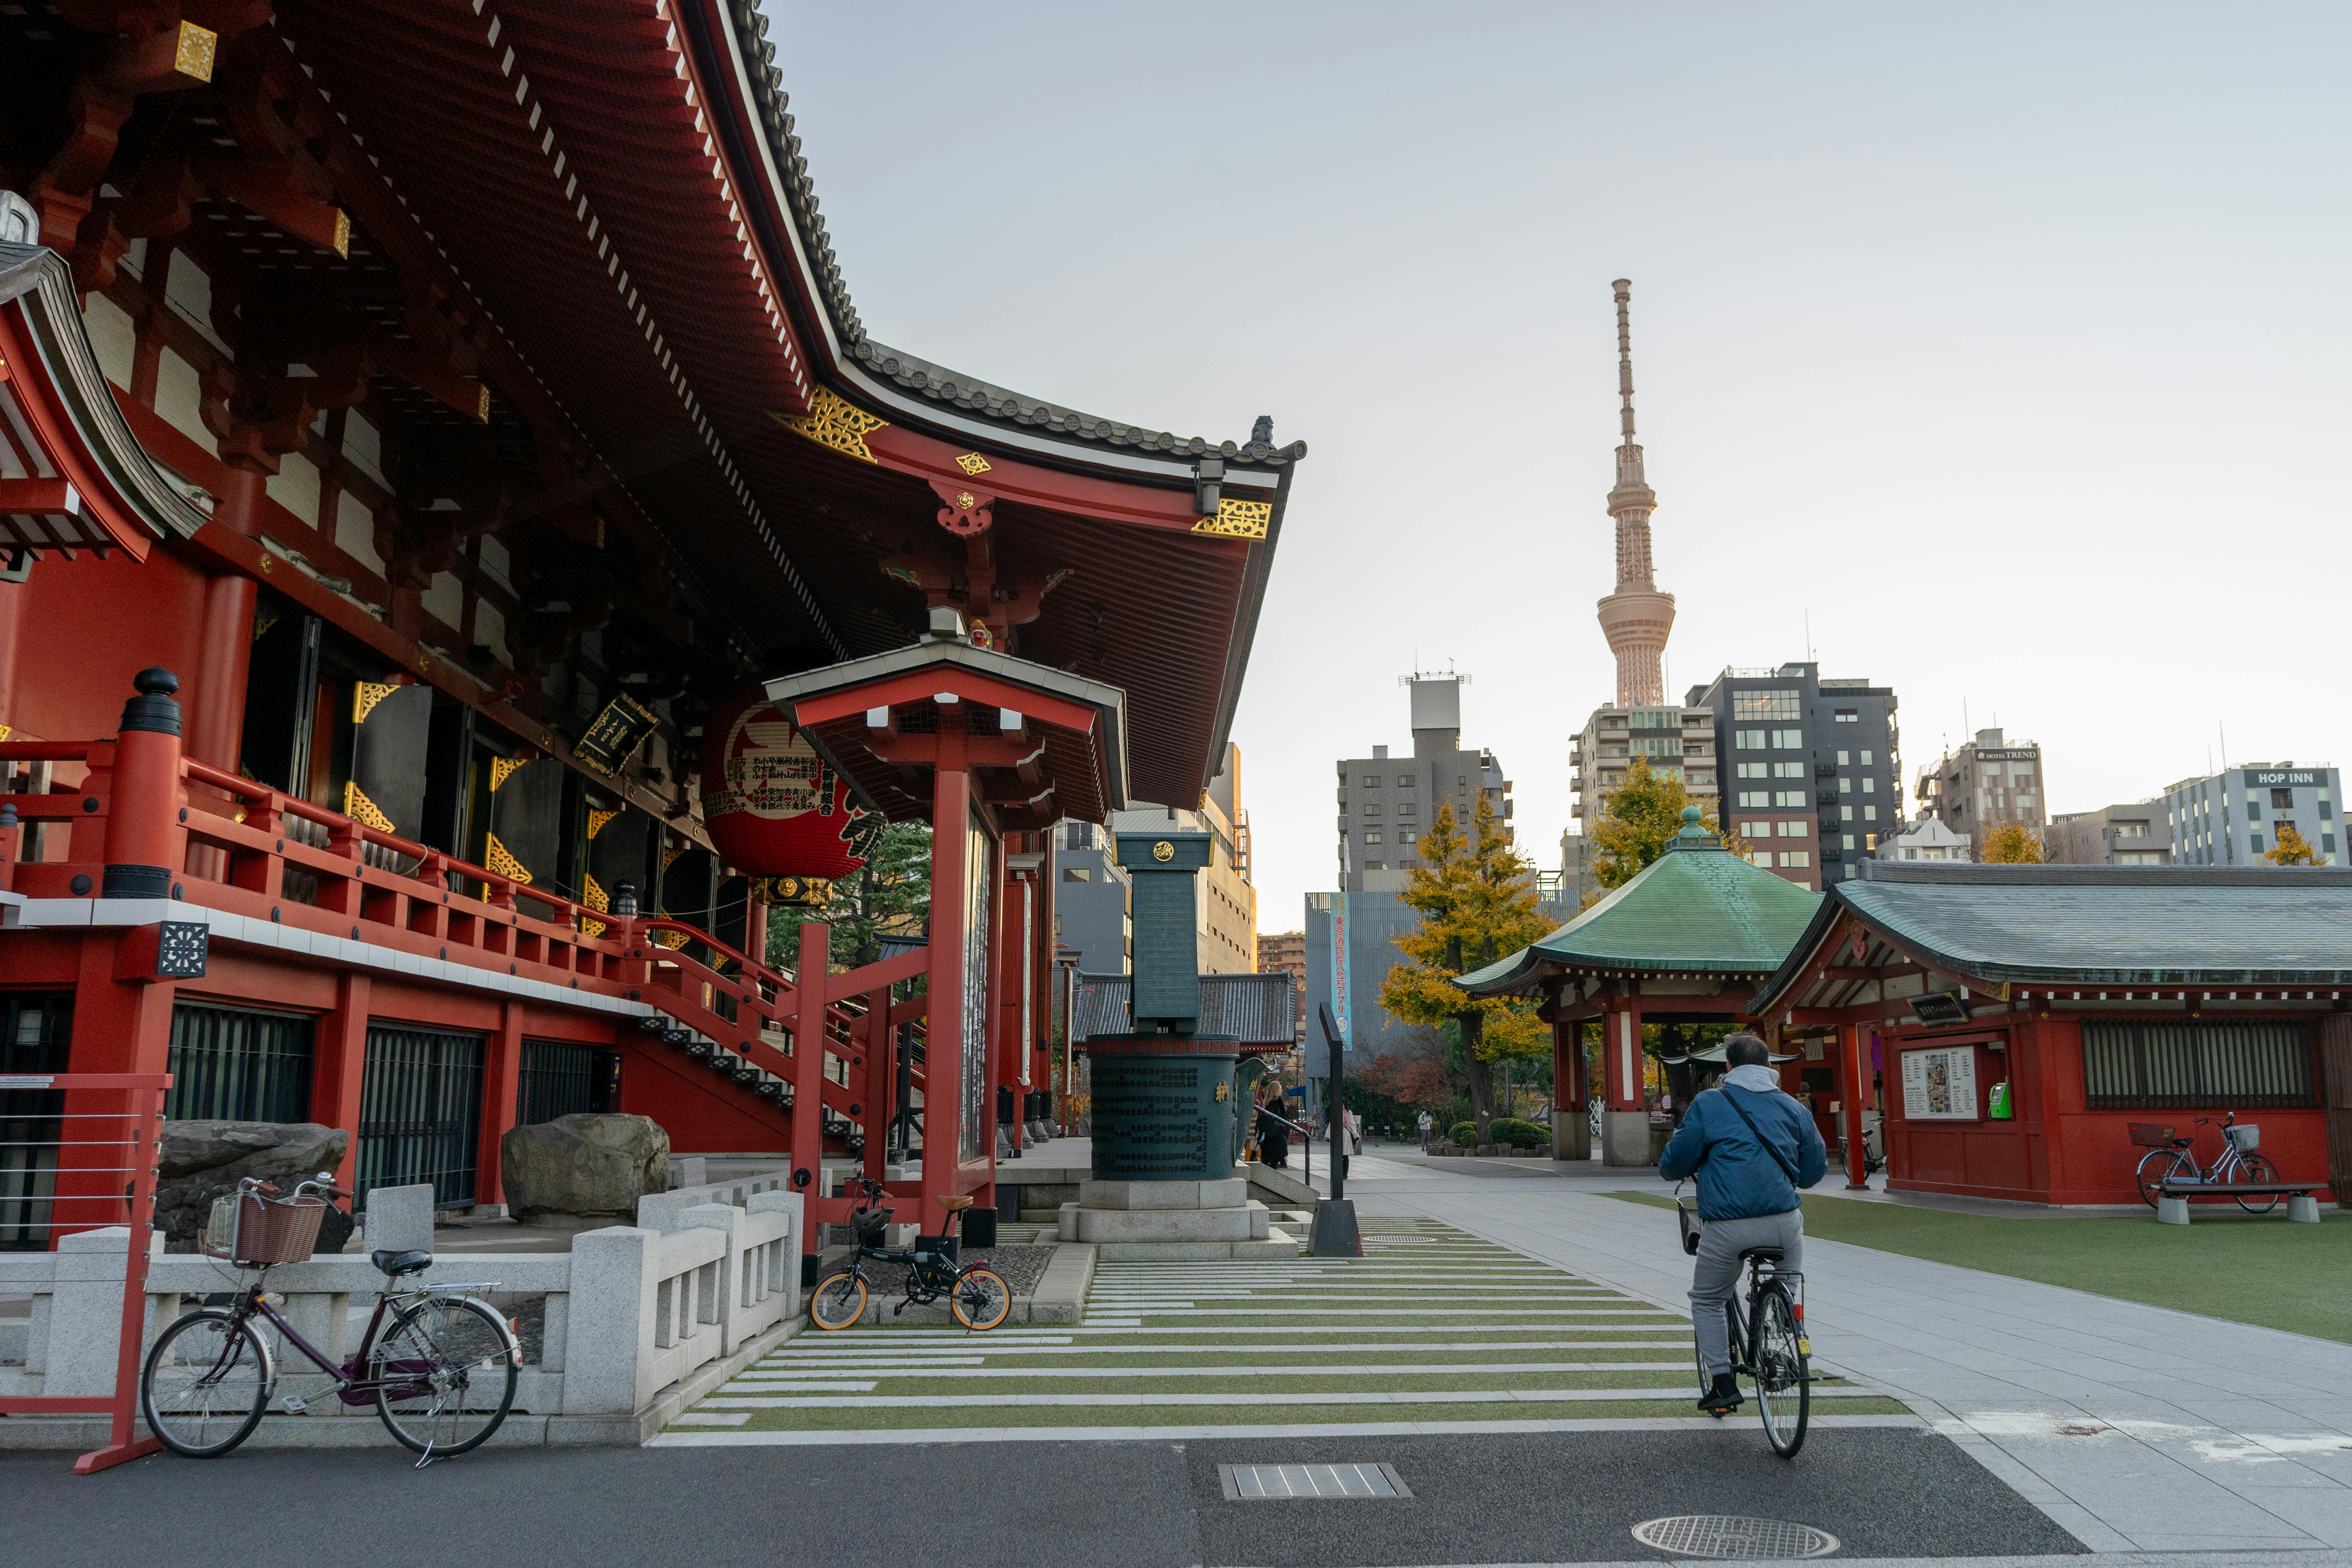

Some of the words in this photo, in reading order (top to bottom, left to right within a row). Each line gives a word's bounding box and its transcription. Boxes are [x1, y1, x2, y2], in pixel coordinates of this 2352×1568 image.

[809, 758, 817, 779] 金田中
[2258, 773, 2285, 783] HOP
[2289, 773, 2314, 783] INN
[1334, 916, 1345, 1014] 東京消防庁公式アプリ
[1216, 1081, 1229, 1103] 納
